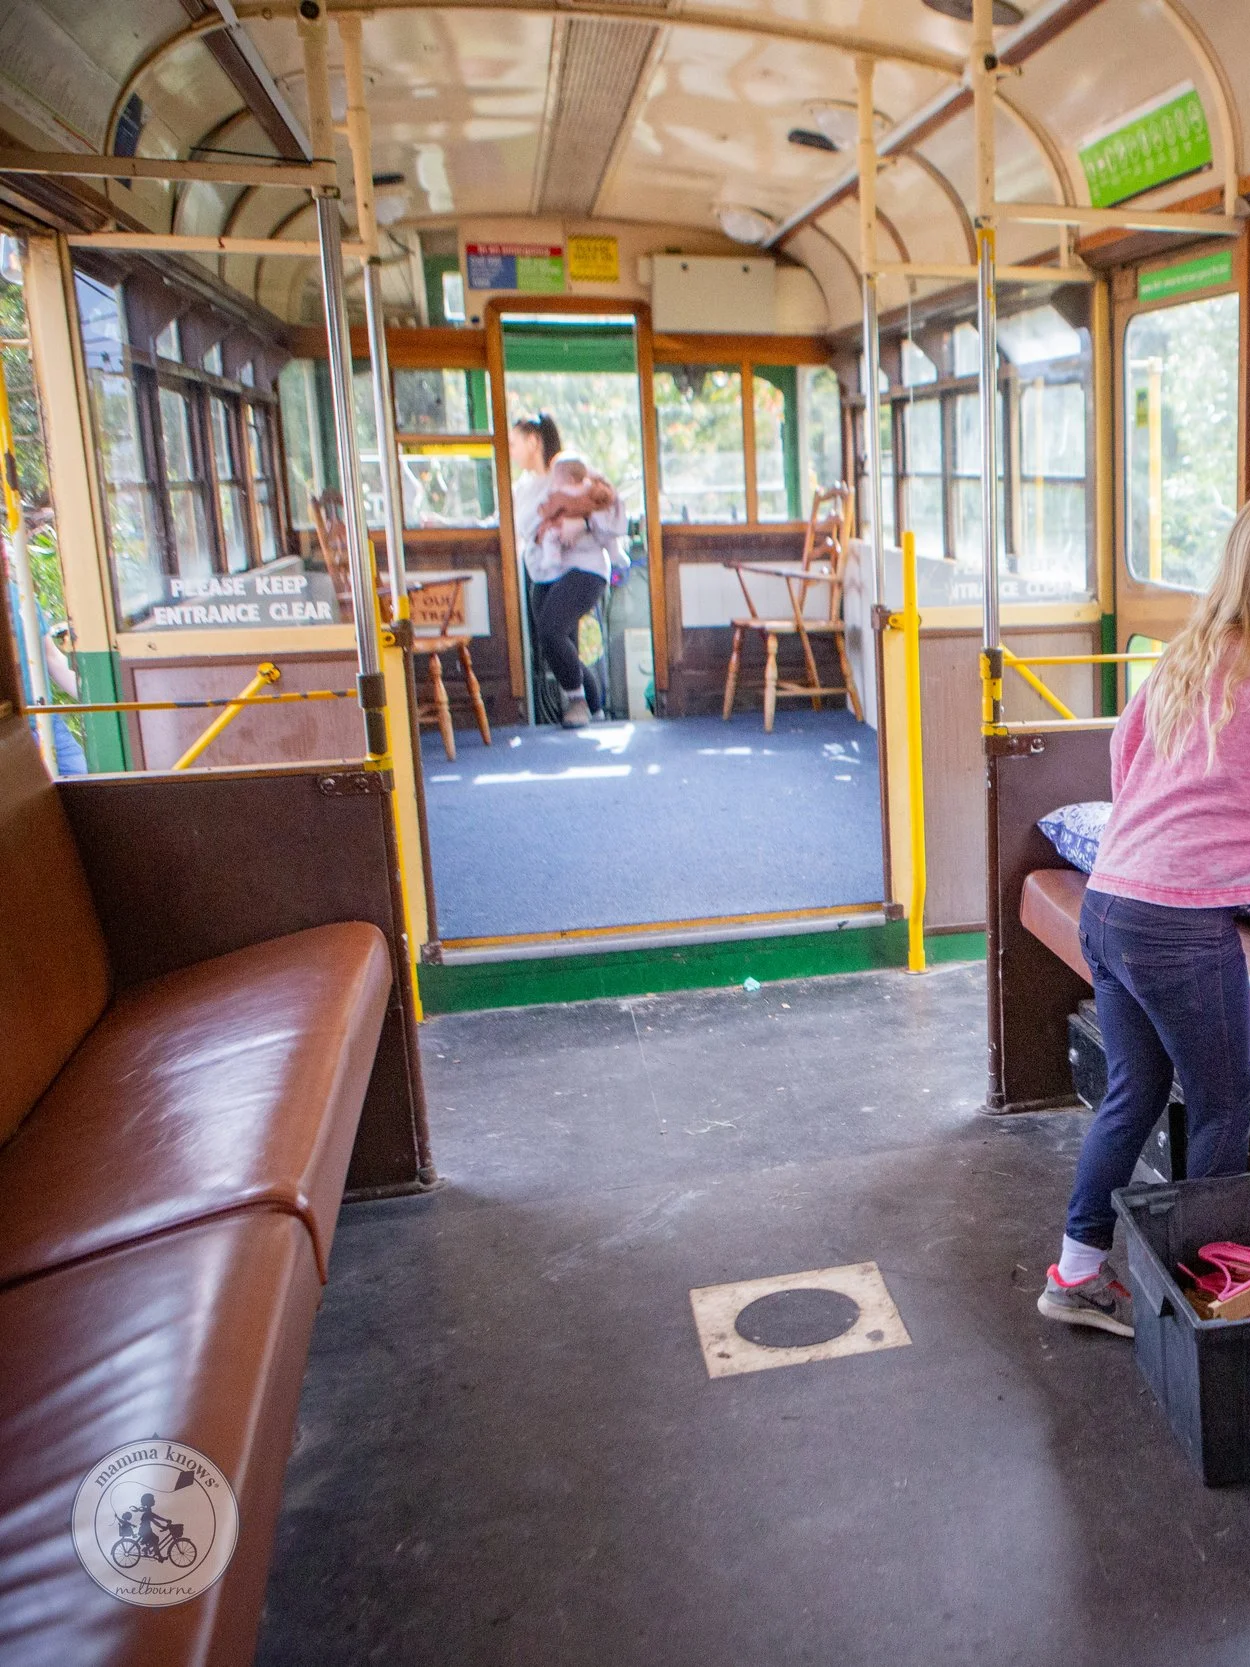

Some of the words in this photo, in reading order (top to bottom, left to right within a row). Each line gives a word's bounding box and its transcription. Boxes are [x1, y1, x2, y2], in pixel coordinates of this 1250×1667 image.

[170, 577, 246, 597] PLEASE
[255, 575, 307, 594] KEEP
[153, 603, 260, 625] ENTRANCE
[269, 601, 332, 620] CLEAR
